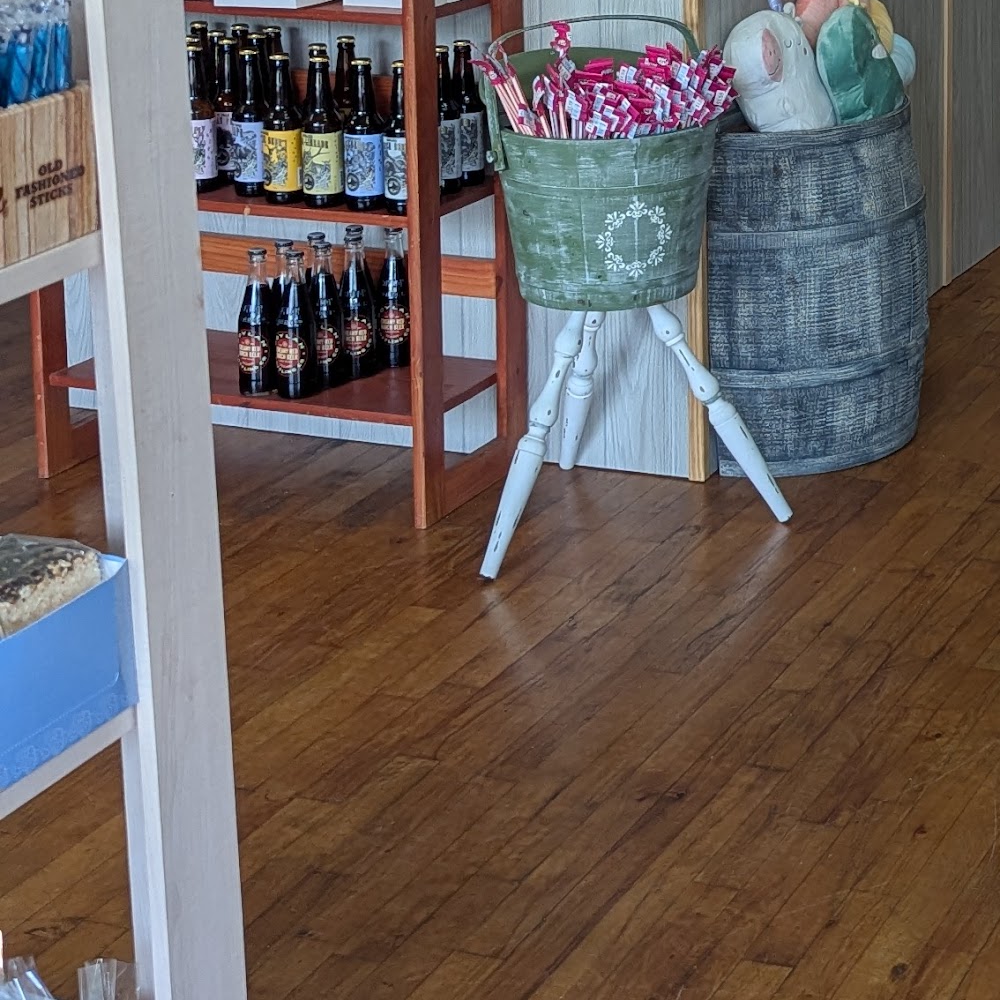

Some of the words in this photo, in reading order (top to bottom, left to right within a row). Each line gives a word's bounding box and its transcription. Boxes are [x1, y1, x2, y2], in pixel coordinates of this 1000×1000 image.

[38, 159, 63, 176] OLD
[15, 164, 85, 199] FASHIONED
[30, 183, 73, 209] STICKS
